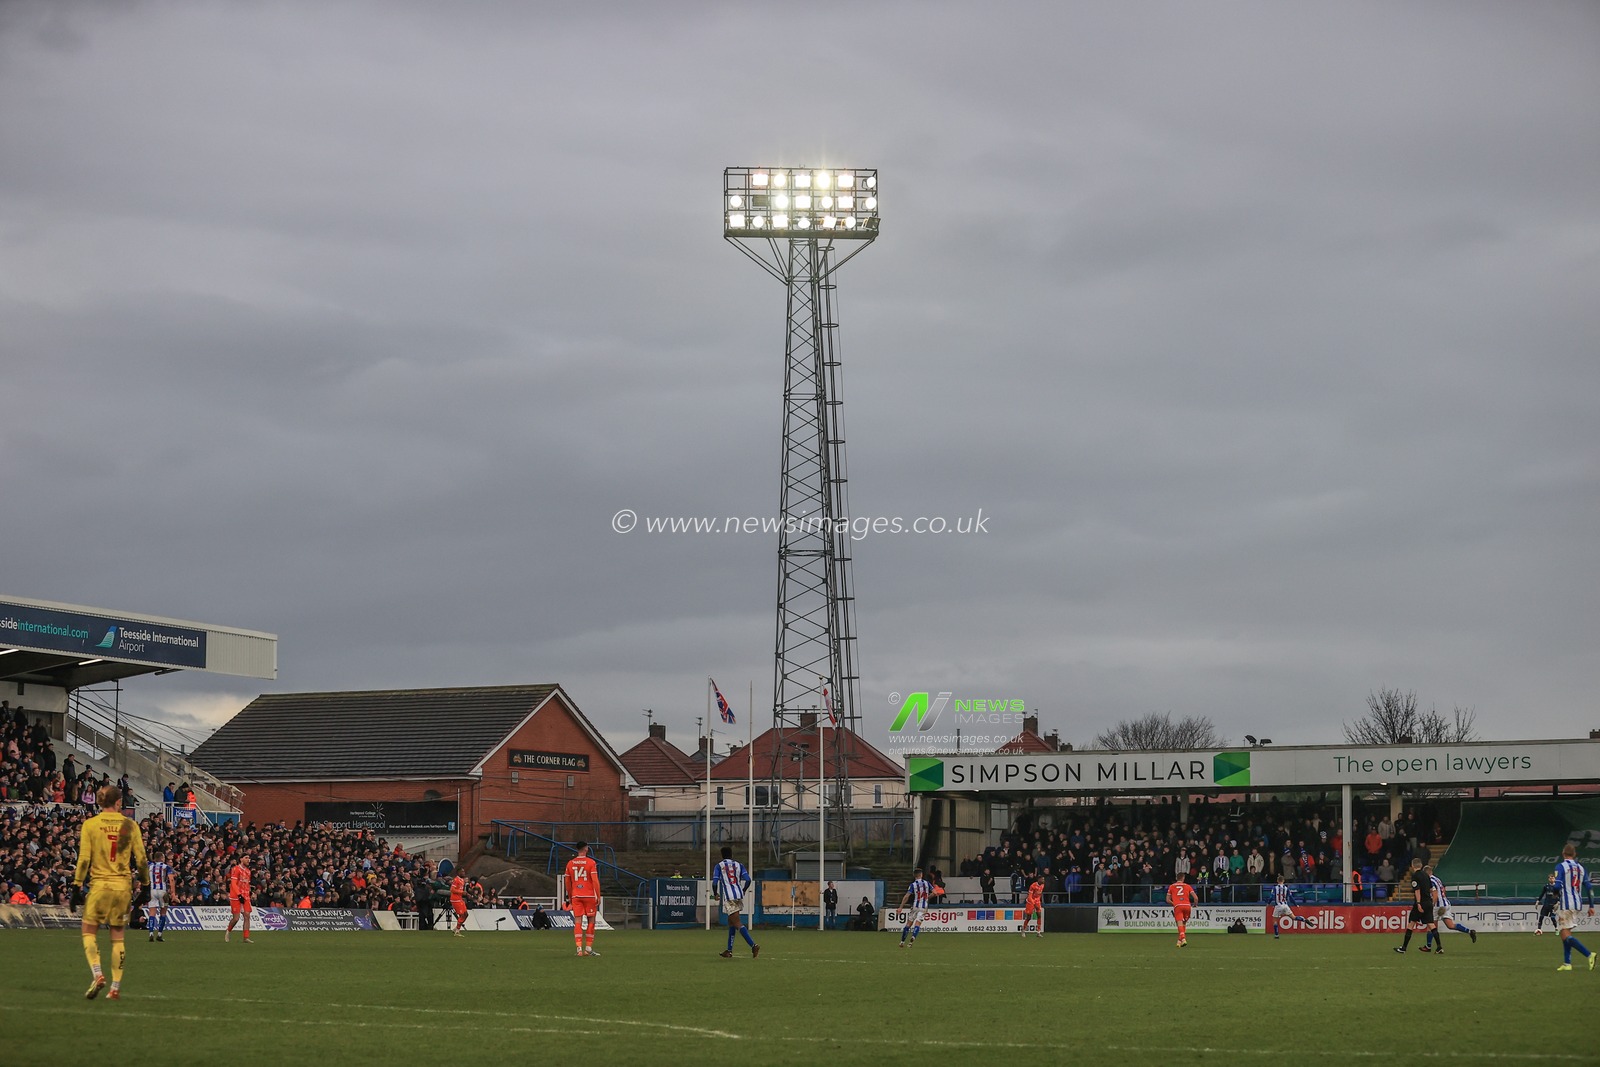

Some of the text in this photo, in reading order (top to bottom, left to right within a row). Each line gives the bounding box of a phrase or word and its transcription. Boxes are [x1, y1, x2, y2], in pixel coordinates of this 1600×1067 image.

[119, 627, 199, 648] Teesside International
[118, 641, 145, 654] Airport
[523, 754, 576, 767] THE CORNER FLAG
[1333, 753, 1532, 776] The open lawyers
[951, 760, 1205, 784] SIMPSON MILLAR
[352, 820, 386, 831] Hartlepool
[1481, 855, 1560, 864] Nuffield
[572, 866, 587, 881] 14
[1176, 886, 1184, 896] 2
